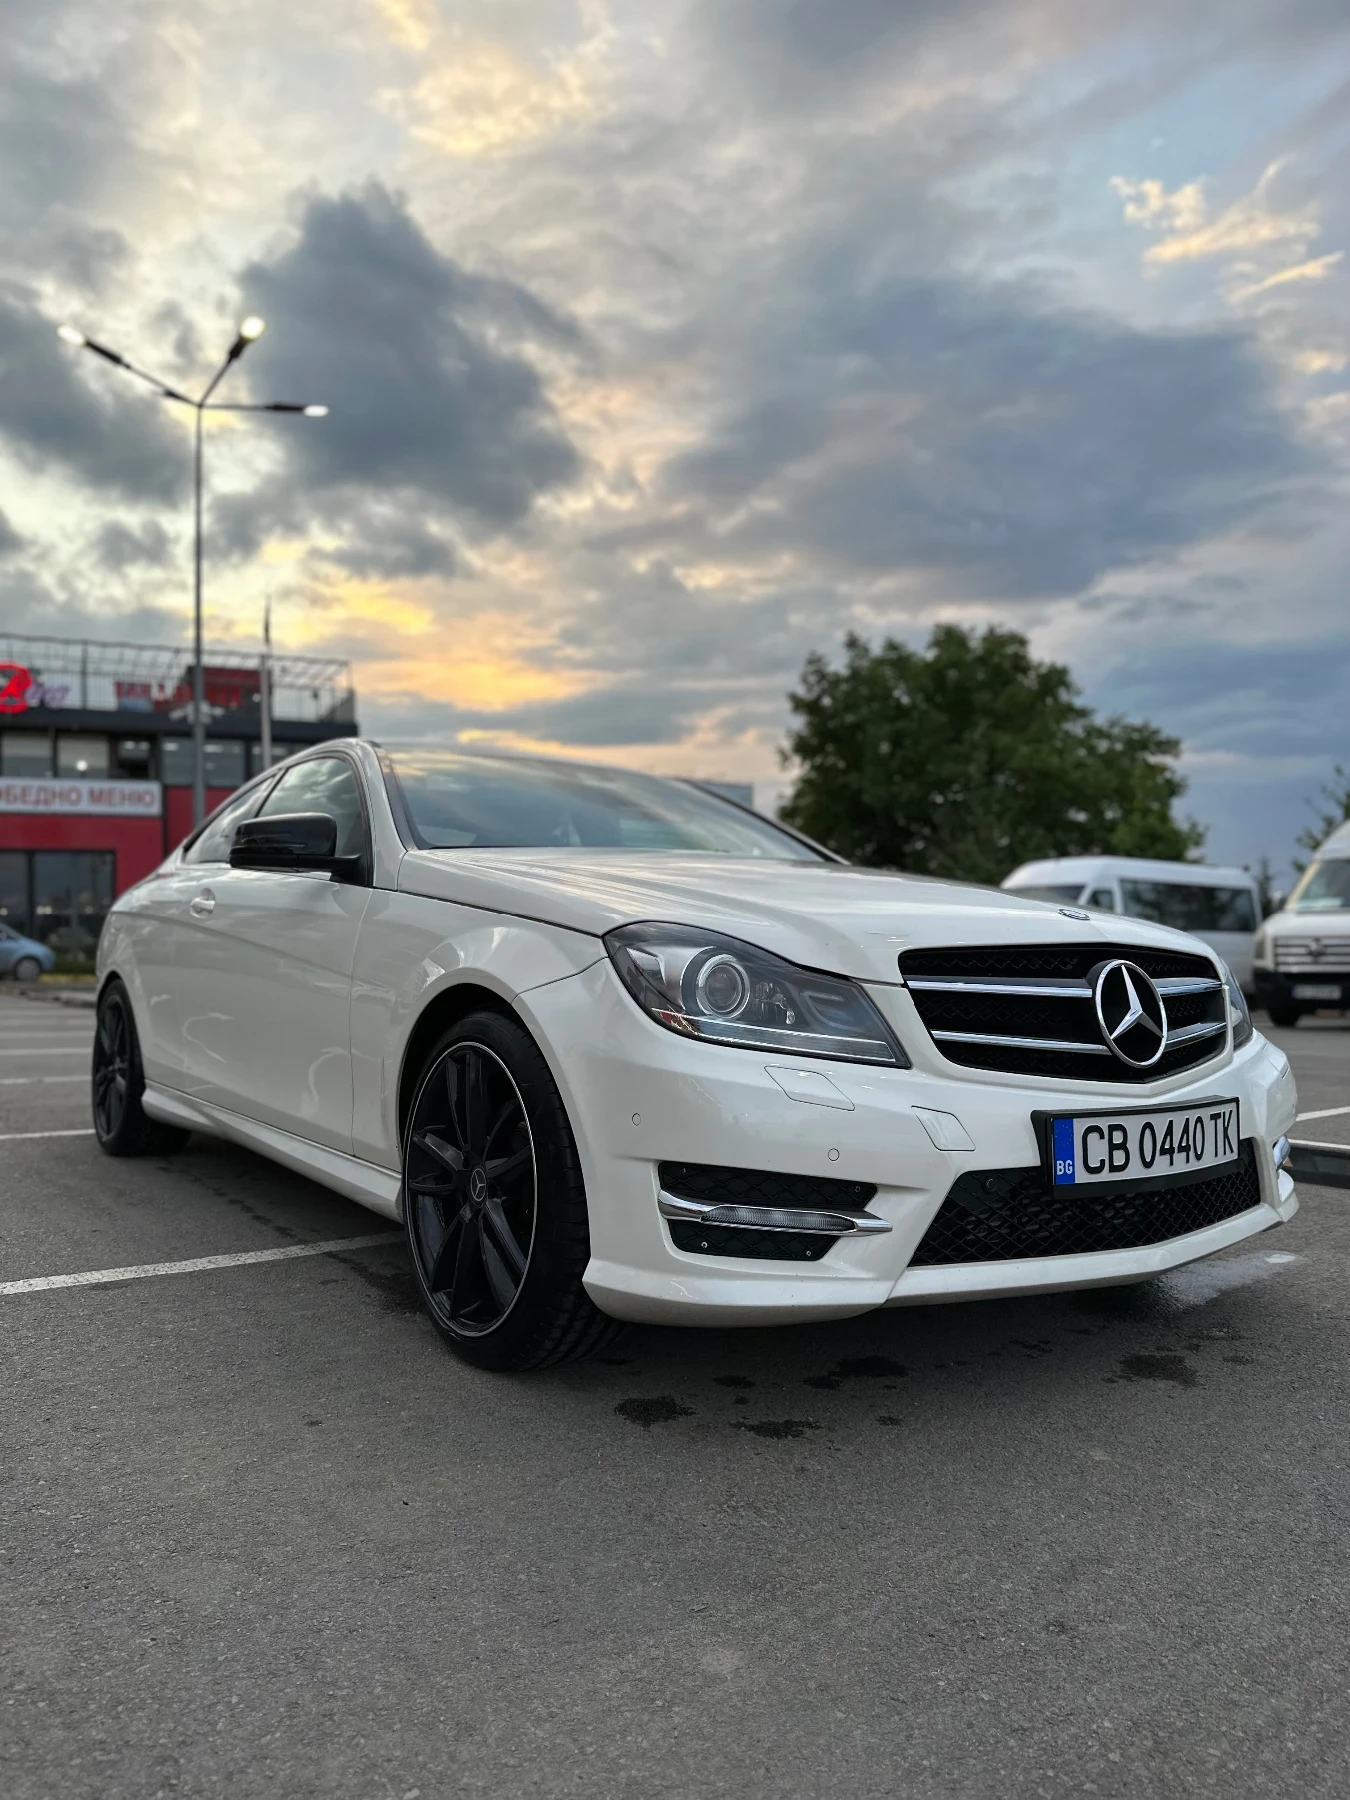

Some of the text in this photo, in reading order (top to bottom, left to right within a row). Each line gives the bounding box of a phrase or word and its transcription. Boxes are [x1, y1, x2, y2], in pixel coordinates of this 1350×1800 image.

[0, 784, 155, 807] БЕДНО МЕНЮ
[1081, 1109, 1235, 1175] CB 0440 TK
[1056, 1159, 1073, 1176] BG
